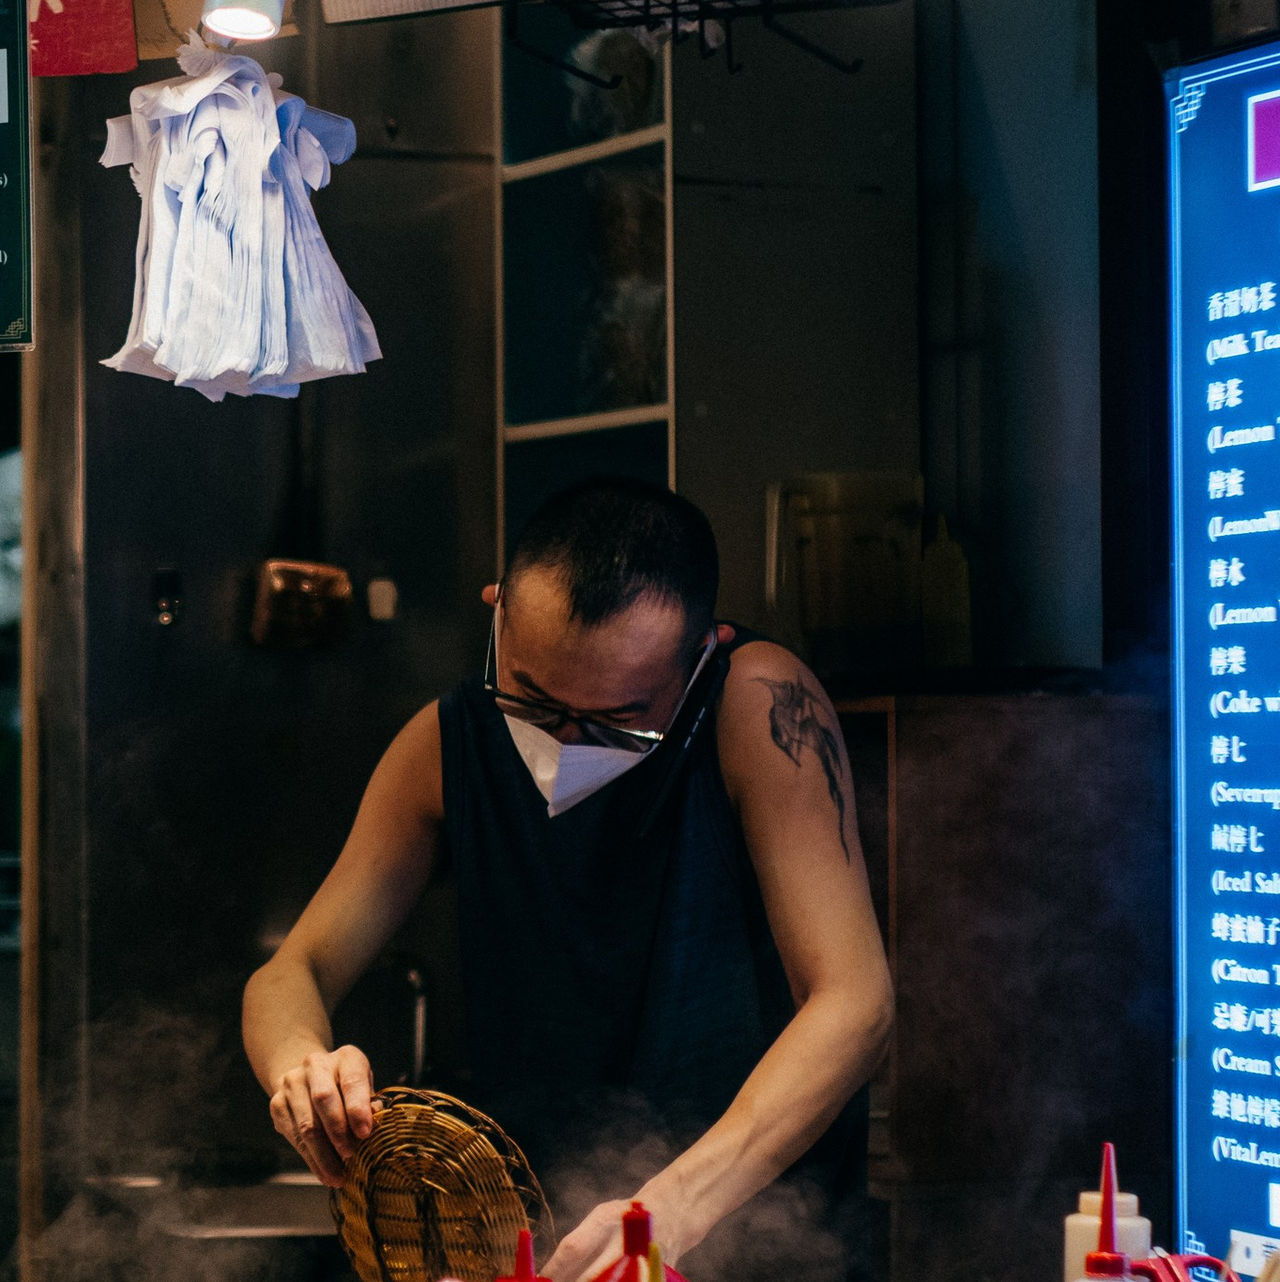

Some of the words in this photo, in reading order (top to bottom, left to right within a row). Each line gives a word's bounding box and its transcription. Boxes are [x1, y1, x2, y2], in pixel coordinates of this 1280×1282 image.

[1206, 333, 1250, 366] (Milk
[1207, 424, 1276, 455] (Lemon
[1209, 602, 1277, 631] (Lemon
[1209, 689, 1263, 719] (Coke
[1211, 869, 1253, 896] (Iced
[1211, 958, 1271, 985] (Citron
[1211, 1046, 1272, 1076] (Cream
